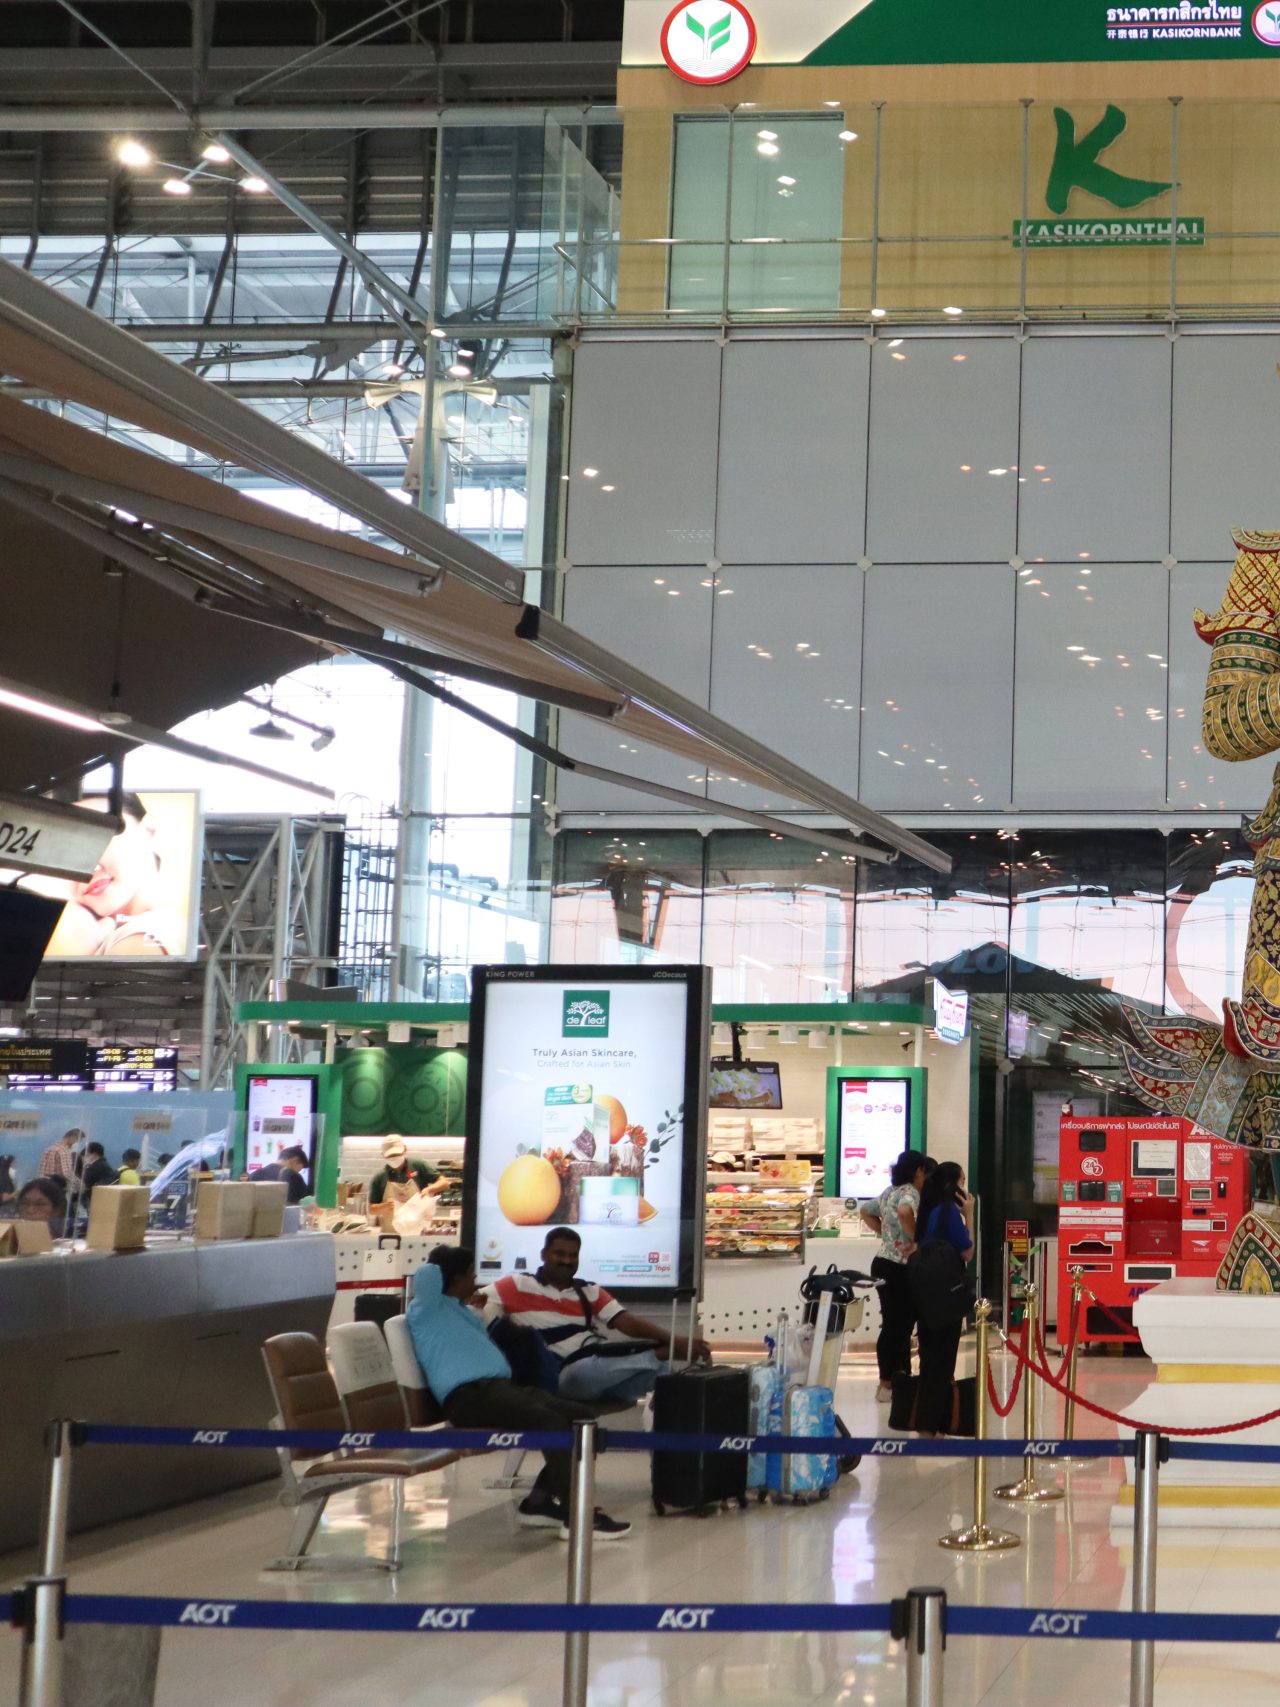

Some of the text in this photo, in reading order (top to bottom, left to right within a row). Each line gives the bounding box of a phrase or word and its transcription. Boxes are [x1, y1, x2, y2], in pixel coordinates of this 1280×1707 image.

[1107, 0, 1242, 21] ธนาคารกสิกรไทย
[1153, 28, 1241, 38] KASIKORNBANK
[652, 971, 687, 979] JCDecaux
[566, 1016, 606, 1025] de leaf
[533, 1048, 637, 1059] Truly Asian Skincare,
[537, 1060, 631, 1068] Crafted for Asian Skin
[654, 1264, 671, 1272] Tops
[193, 1431, 227, 1444] AOT
[339, 1433, 375, 1446] AOT
[487, 1433, 522, 1446] AOT
[720, 1437, 756, 1451] AOT
[871, 1441, 907, 1454] AOT
[1024, 1441, 1060, 1455] AOT
[179, 1603, 237, 1624] AOT
[418, 1608, 475, 1628] AOT
[657, 1608, 714, 1629] AOT
[1029, 1613, 1087, 1634] AOT
